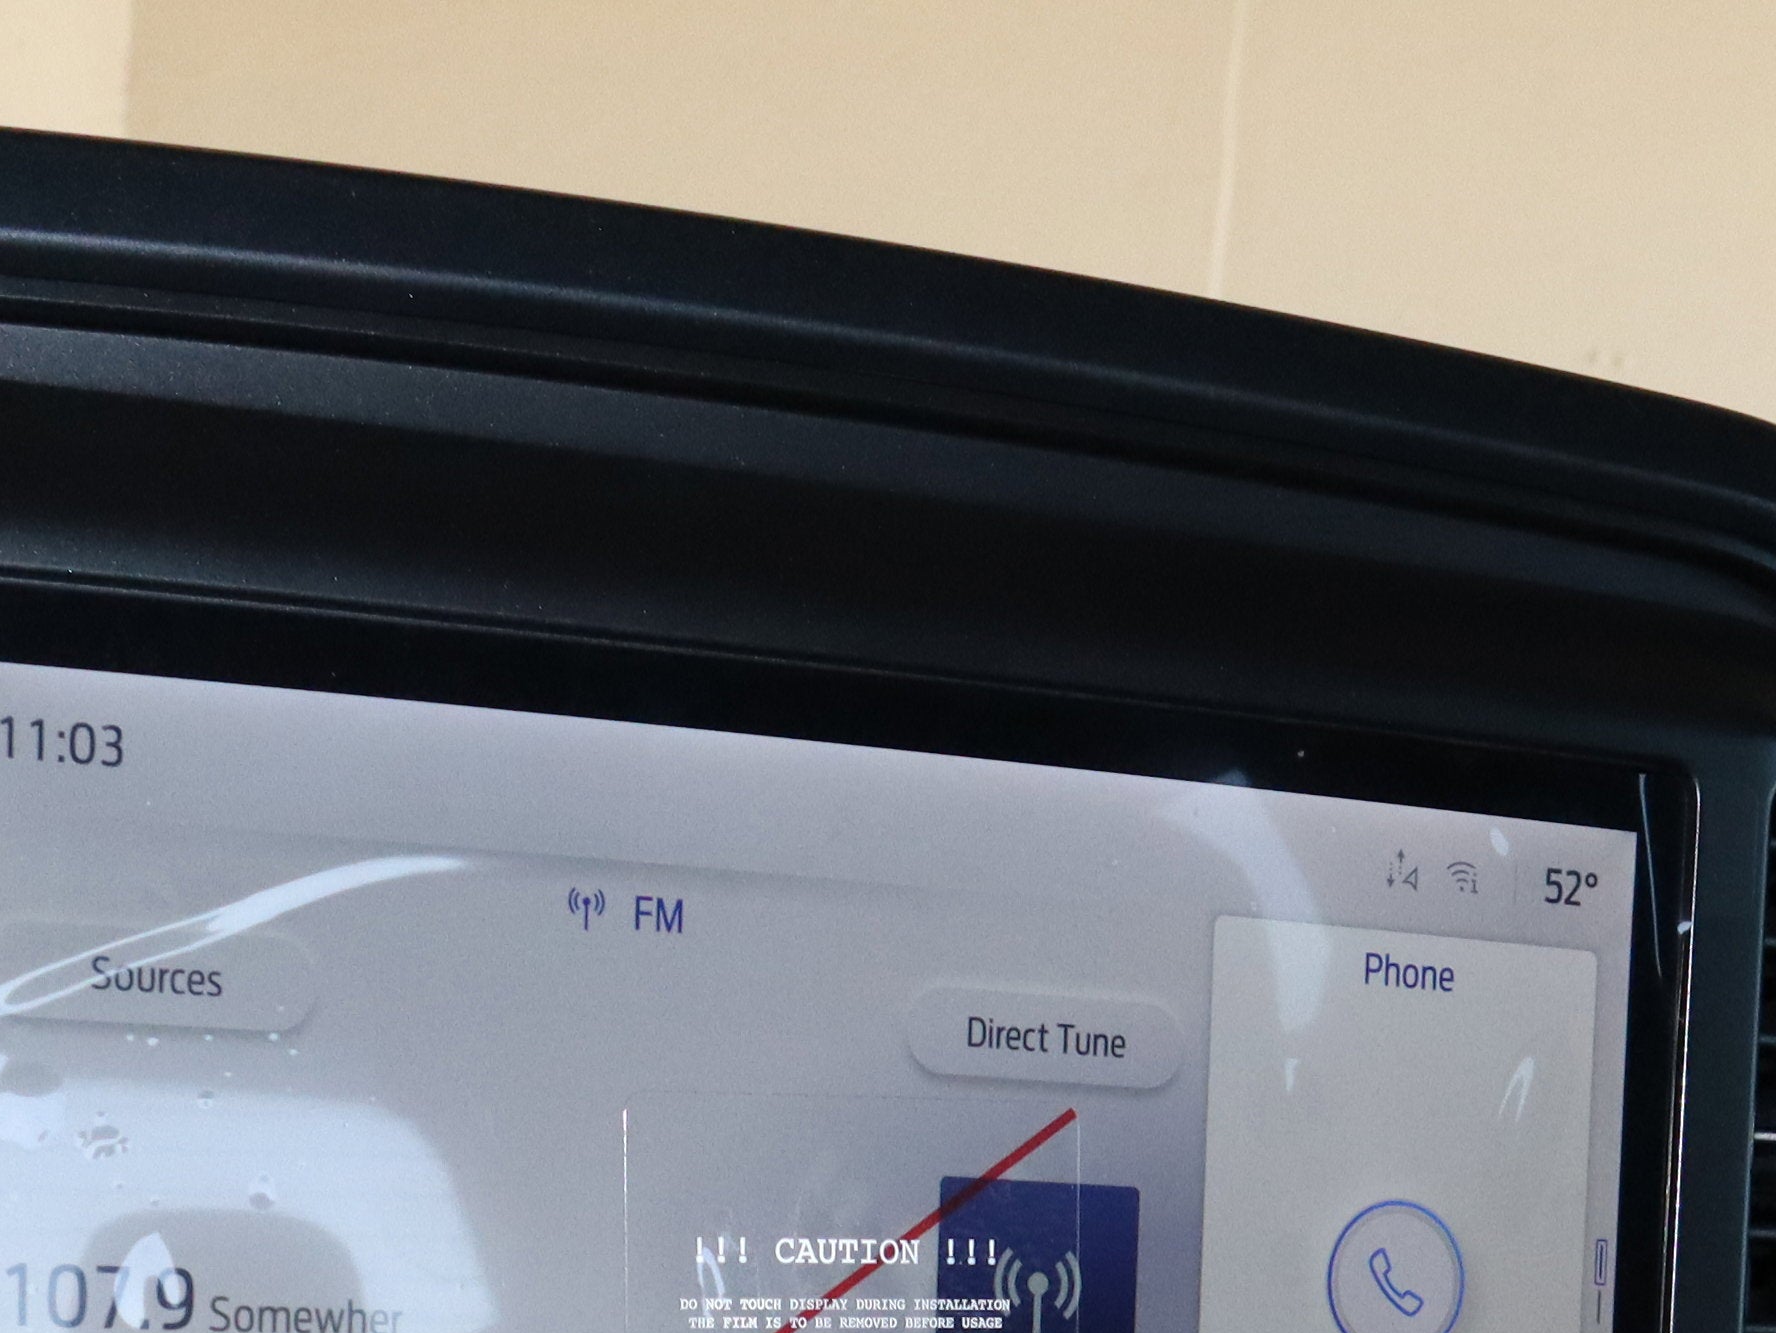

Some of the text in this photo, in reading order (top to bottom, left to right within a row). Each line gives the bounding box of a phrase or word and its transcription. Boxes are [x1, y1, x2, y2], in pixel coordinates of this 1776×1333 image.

[634, 894, 684, 934] FM
[90, 956, 223, 998] Sources
[1363, 952, 1456, 993] Phone
[967, 1016, 1127, 1061] Direct Tune
[775, 1238, 920, 1266] CAUTION
[4, 1262, 195, 1331] 107.9
[679, 1298, 1011, 1312] DO NOT TOUCH DISPLAY DURING INSTALLATION
[688, 1316, 1003, 1329] THE FILM IS TO BE REMOVED BEFORE USAGE
